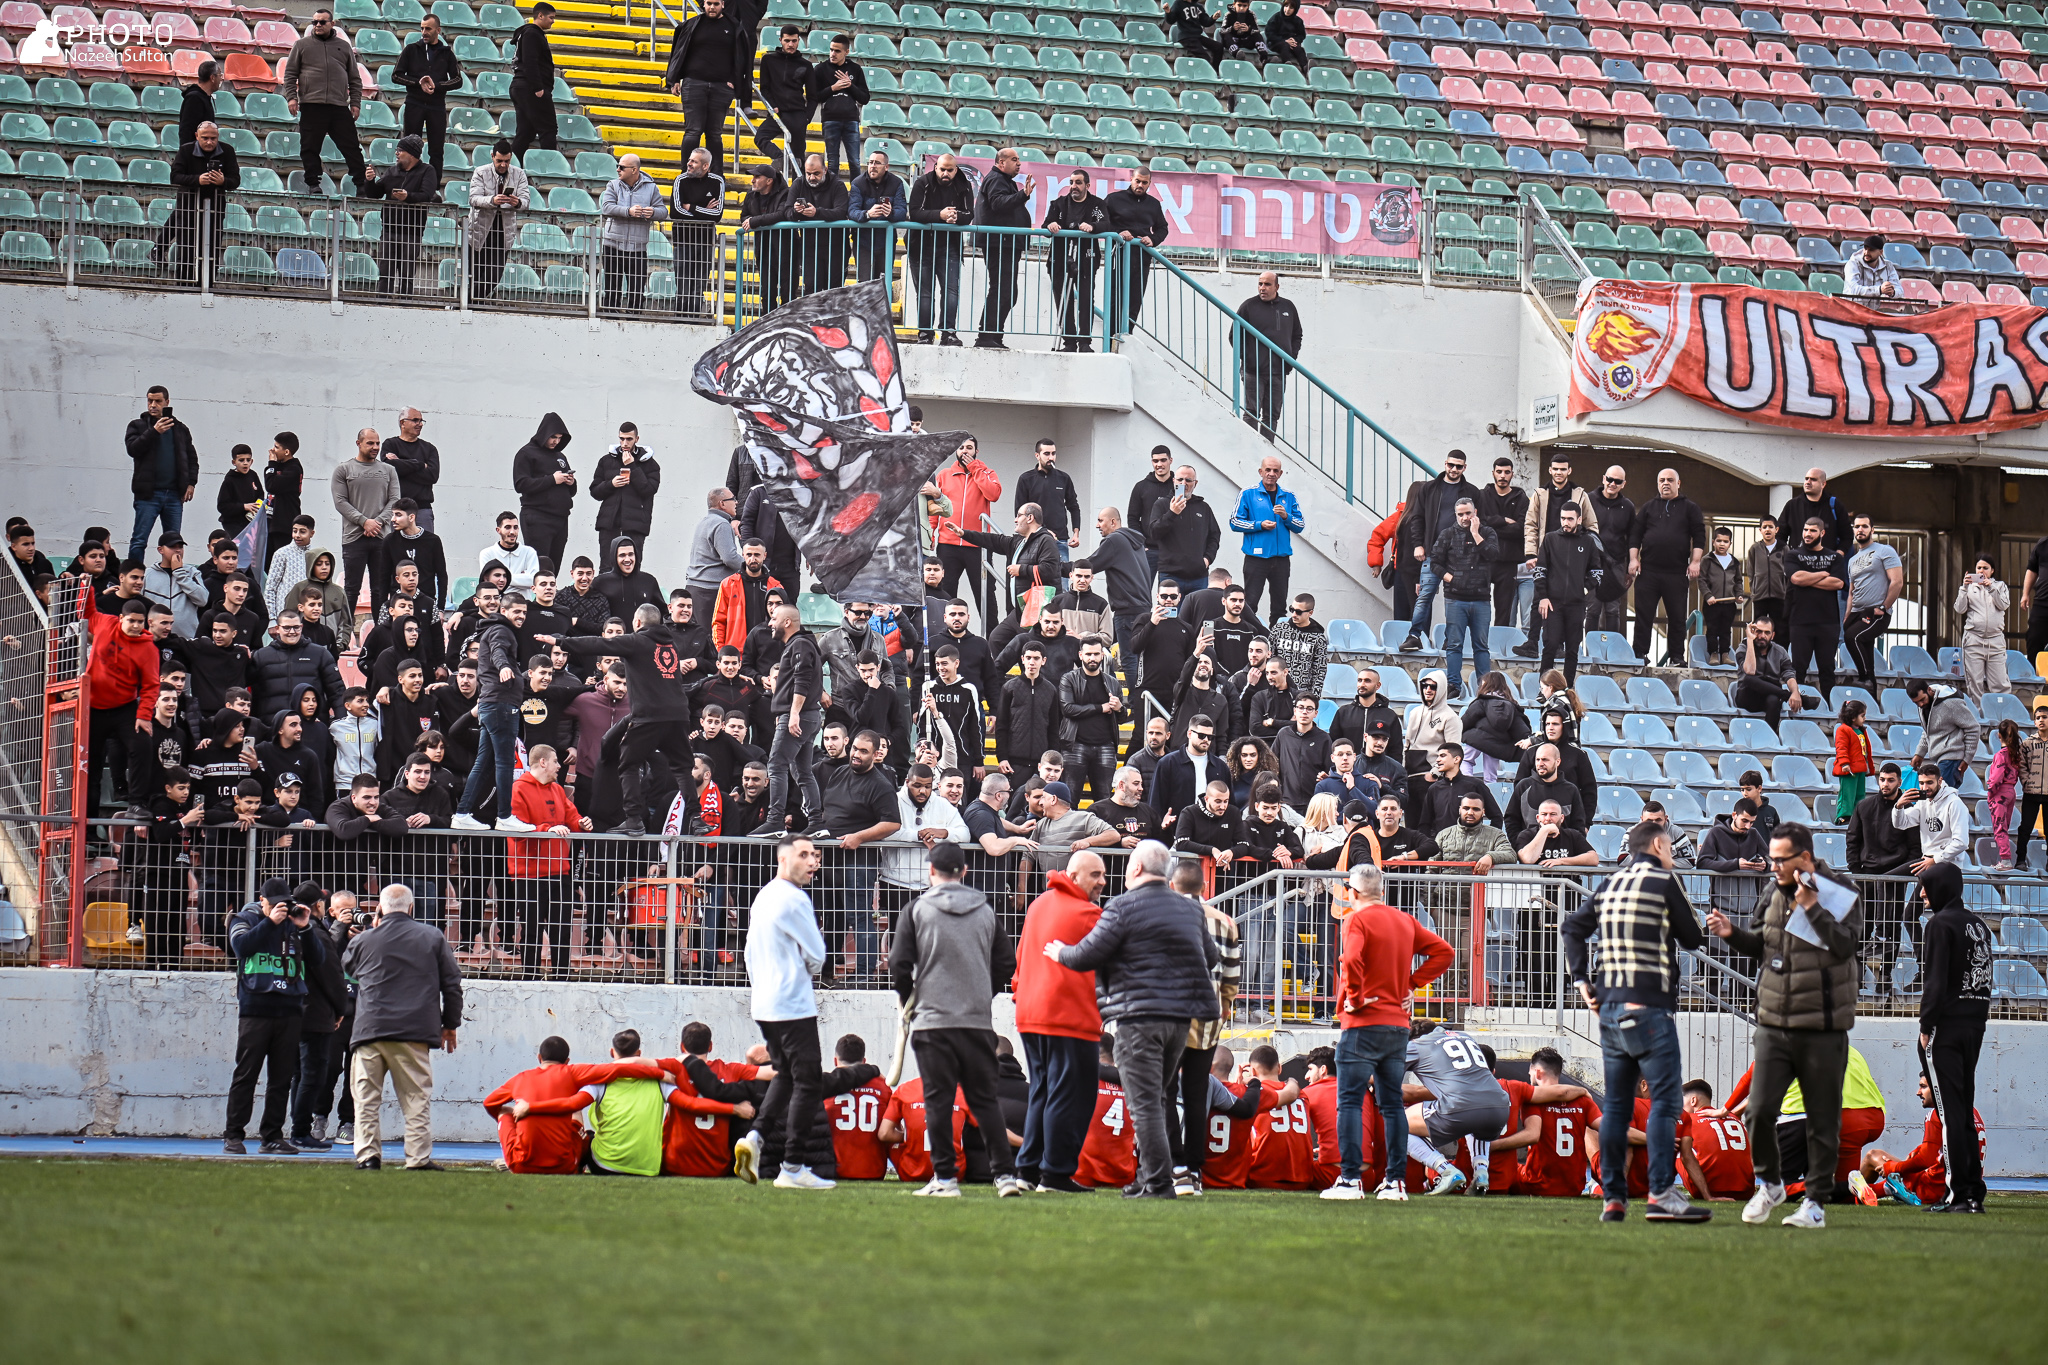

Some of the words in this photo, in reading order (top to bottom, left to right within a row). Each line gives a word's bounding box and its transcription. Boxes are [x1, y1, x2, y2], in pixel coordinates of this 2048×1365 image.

[1221, 186, 1362, 244] טירה
[1280, 638, 1312, 654] ICON
[935, 693, 960, 703] ICON
[217, 786, 238, 796] ICO
[1442, 1039, 1489, 1070] 96
[834, 1092, 880, 1132] 30
[1101, 1098, 1124, 1136] 4
[1269, 1098, 1308, 1134] 99
[1209, 1114, 1231, 1153] 9
[1555, 1117, 1574, 1157] 6
[1709, 1119, 1747, 1151] 19
